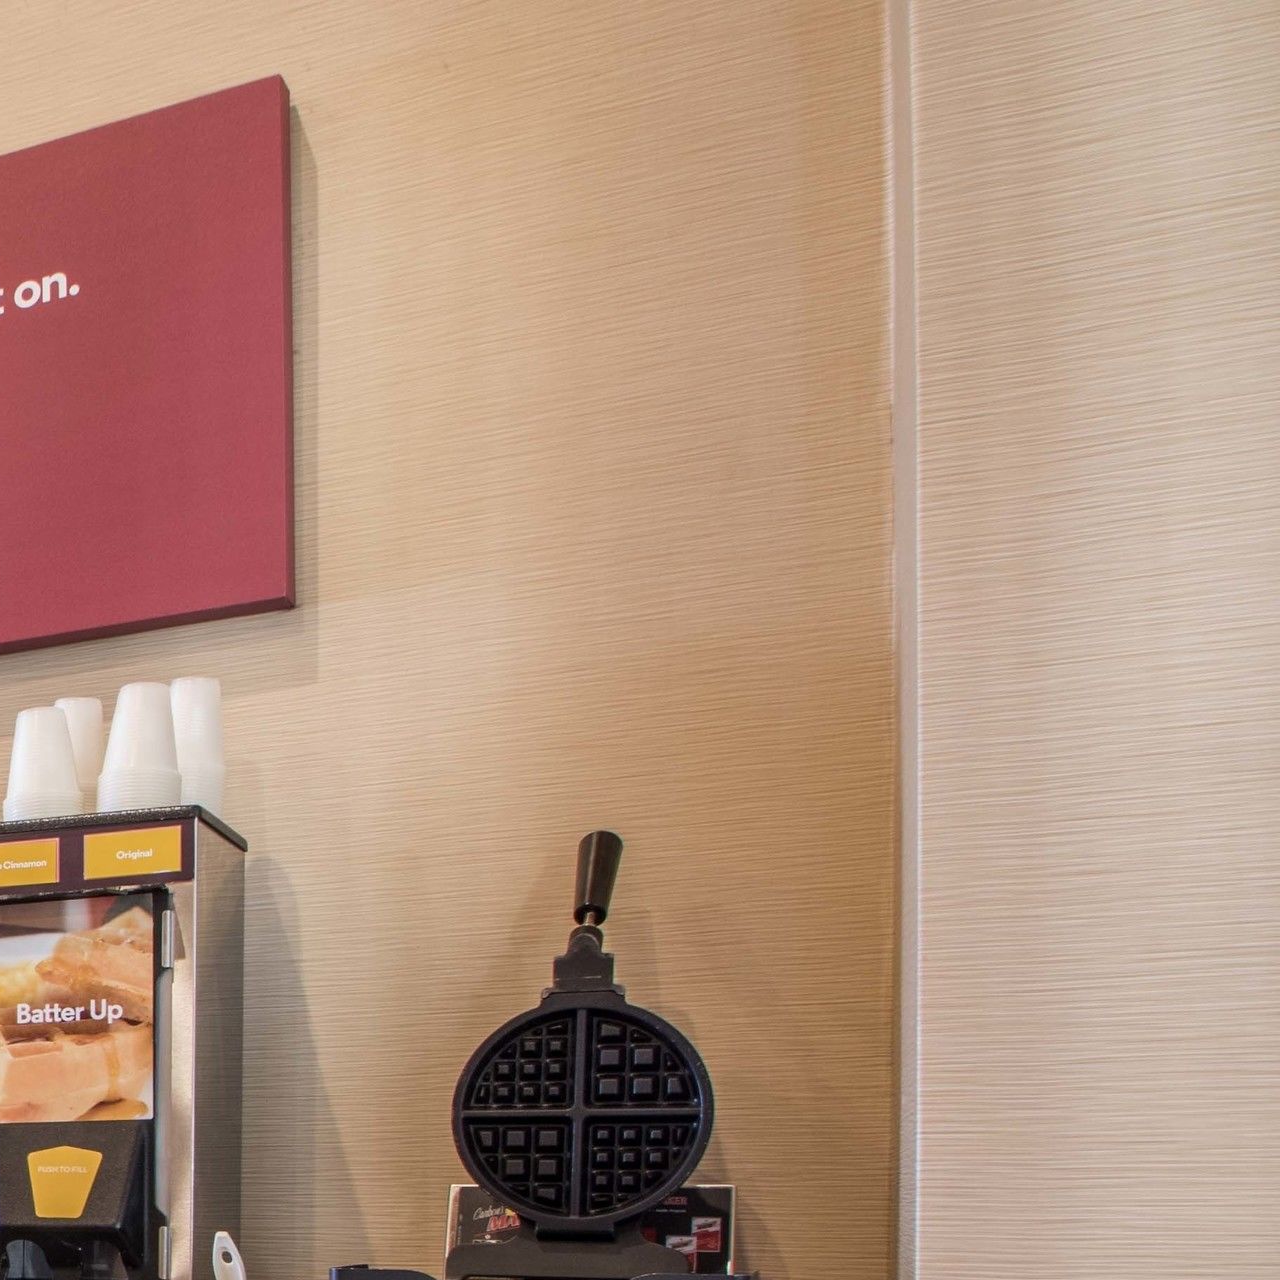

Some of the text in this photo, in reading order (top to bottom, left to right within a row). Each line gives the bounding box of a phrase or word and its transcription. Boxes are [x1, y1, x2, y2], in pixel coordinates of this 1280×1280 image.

[14, 272, 80, 309] on.
[116, 848, 153, 861] Original
[3, 859, 47, 870] Cinnamon
[16, 998, 124, 1024] Batter Up
